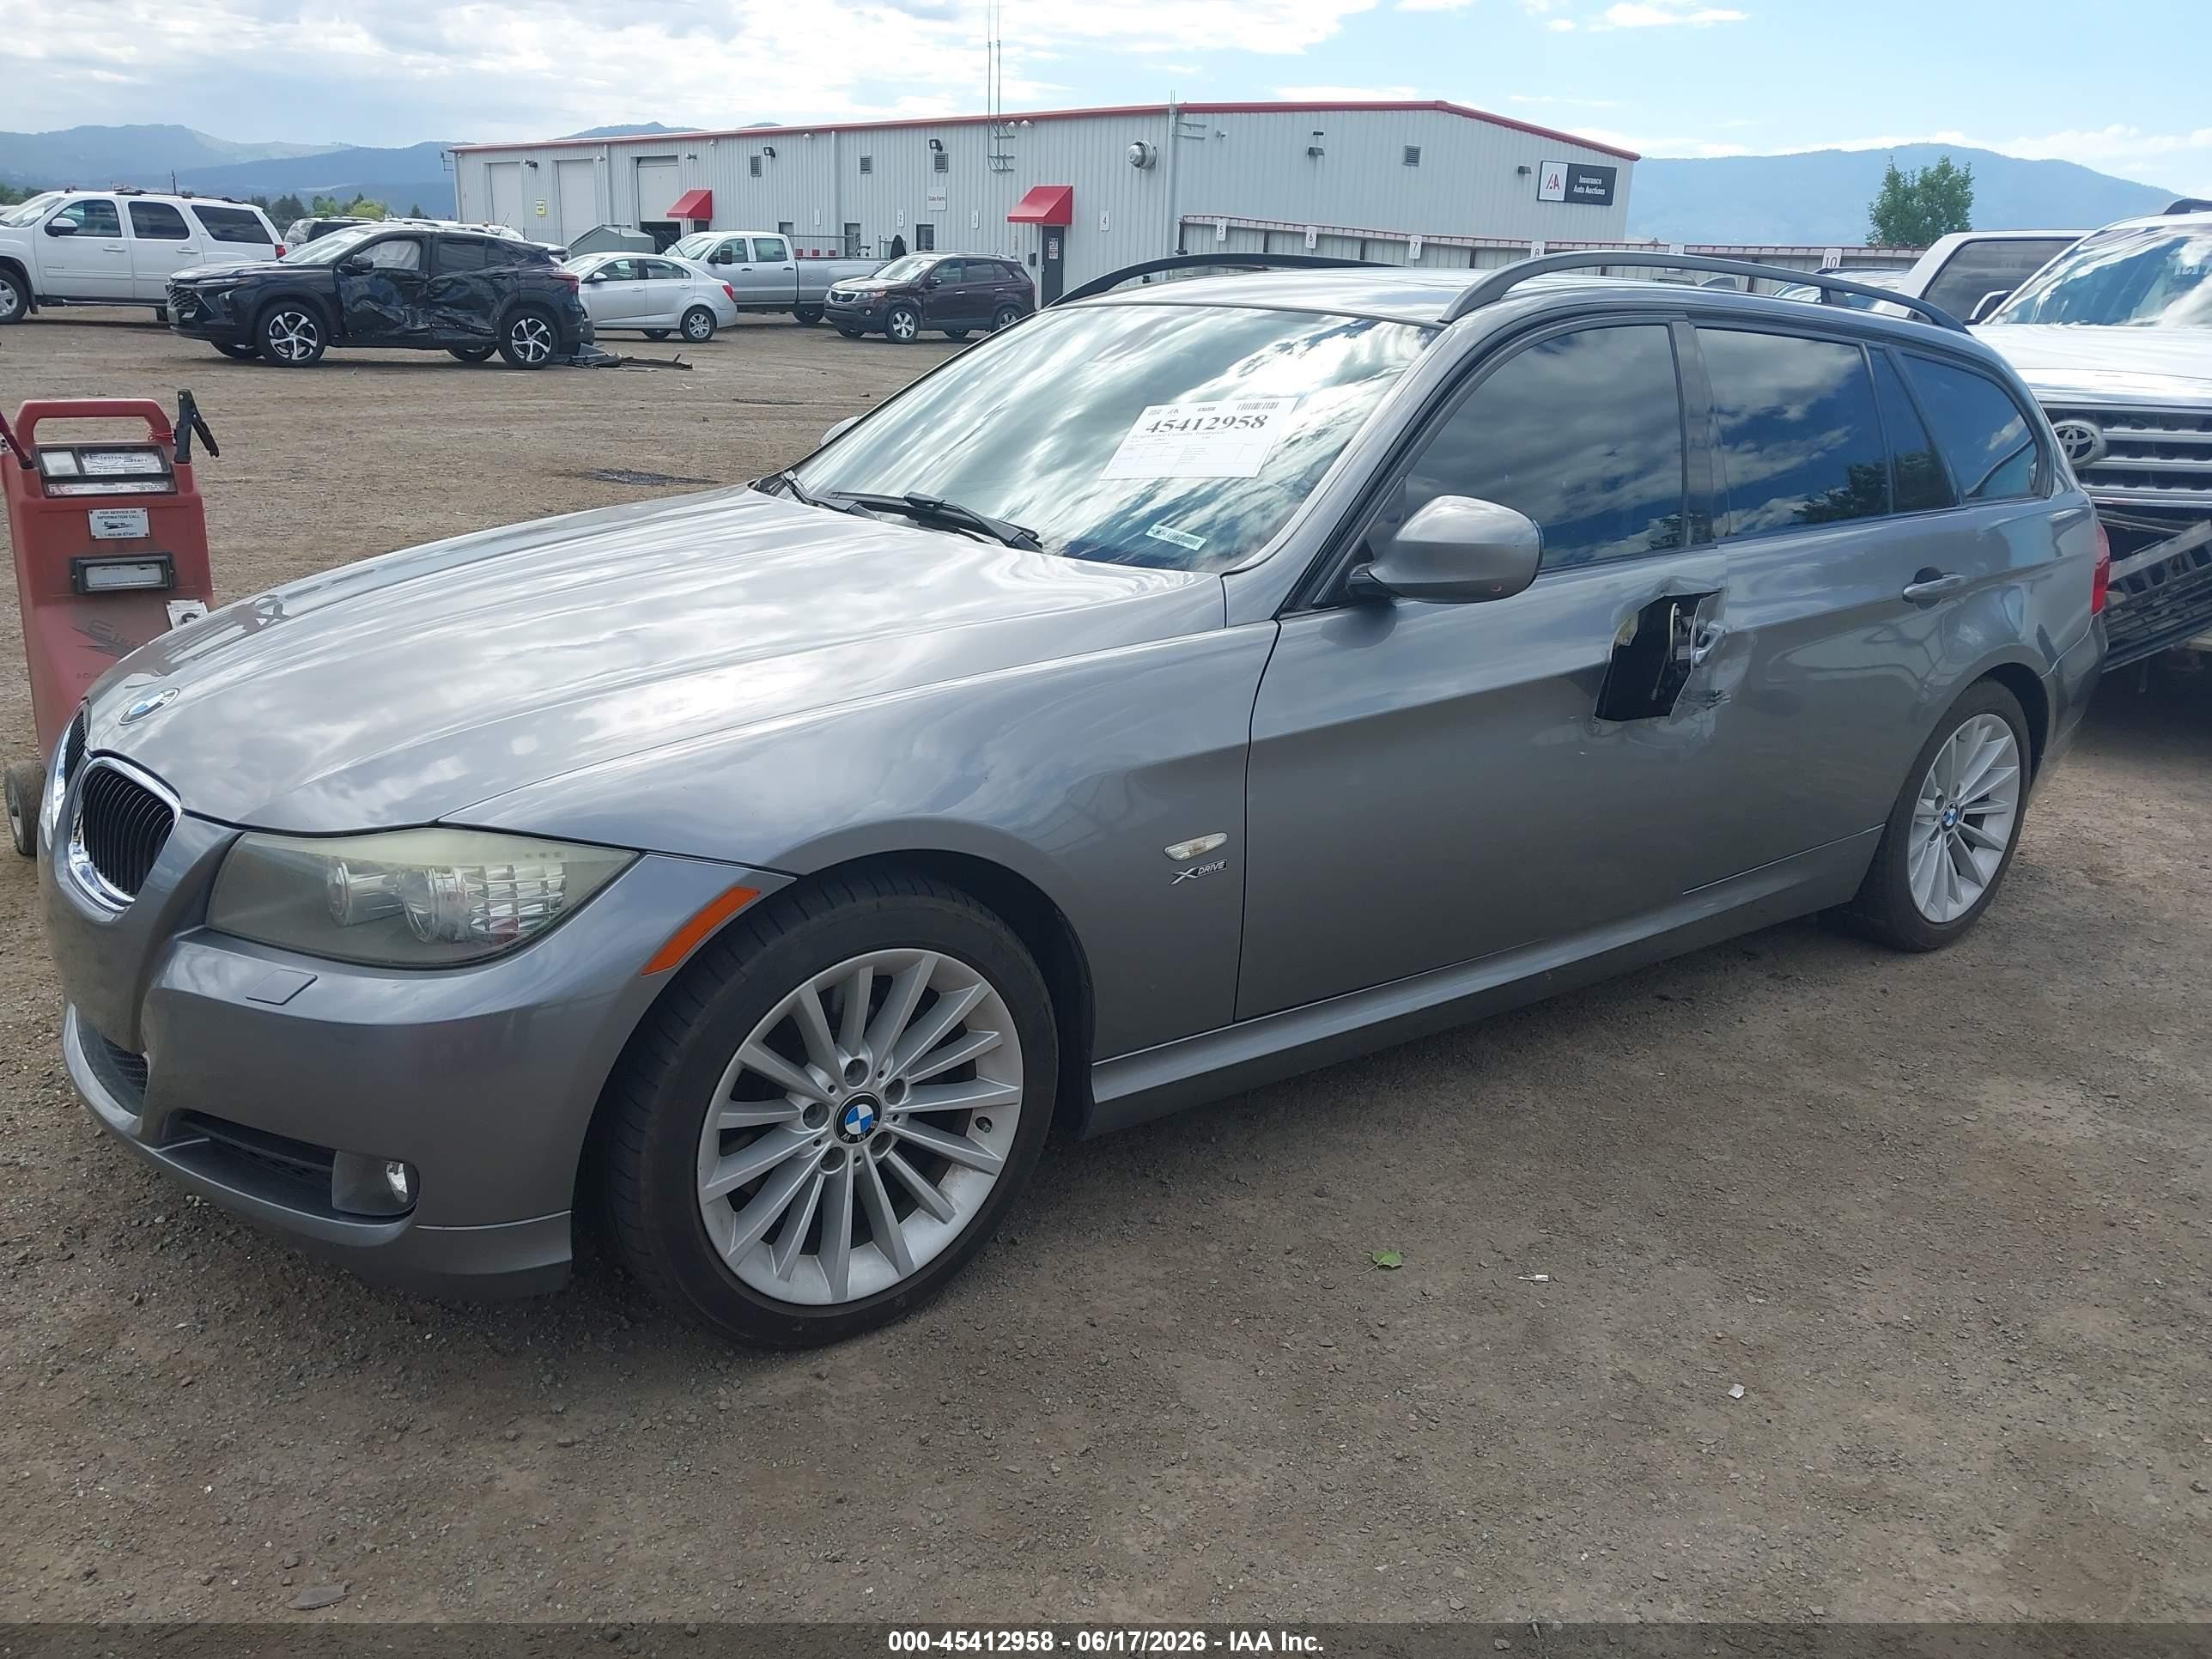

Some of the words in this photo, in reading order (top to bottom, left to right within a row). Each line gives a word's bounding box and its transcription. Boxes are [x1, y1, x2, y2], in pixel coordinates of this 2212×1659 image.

[1579, 174, 1602, 185] Insurance
[1573, 185, 1584, 193] Auto
[1585, 185, 1606, 195] Auctions
[1103, 216, 1107, 226] 4
[1218, 225, 1224, 235] 5
[1309, 233, 1314, 242] 6
[1413, 241, 1419, 252] 7
[1826, 257, 1838, 269] 10
[1146, 415, 1268, 433] 45412958
